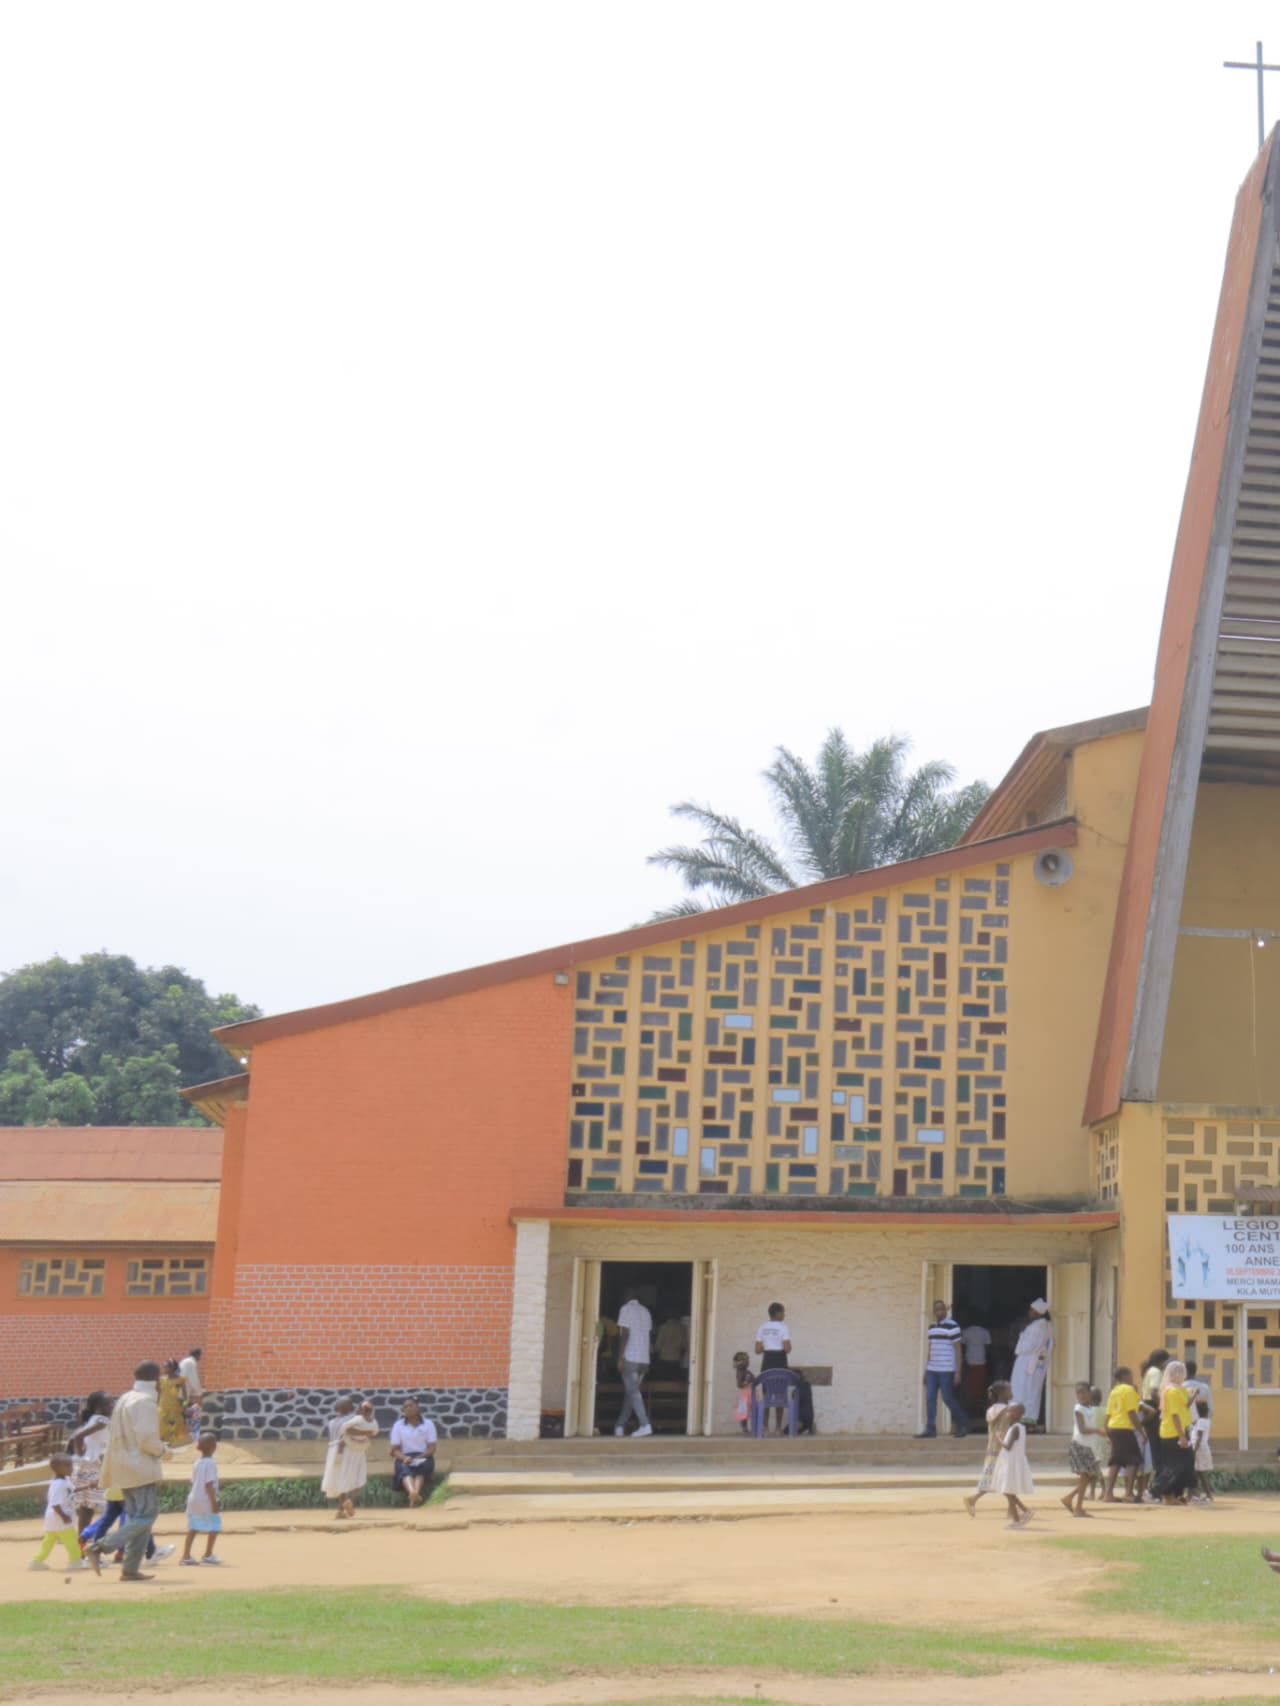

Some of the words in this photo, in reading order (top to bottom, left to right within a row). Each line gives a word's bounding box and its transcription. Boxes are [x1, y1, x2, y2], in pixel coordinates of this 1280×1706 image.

[1223, 1219, 1279, 1231] LEGIO
[1225, 1243, 1245, 1254] 100
[1248, 1243, 1274, 1255] ANS
